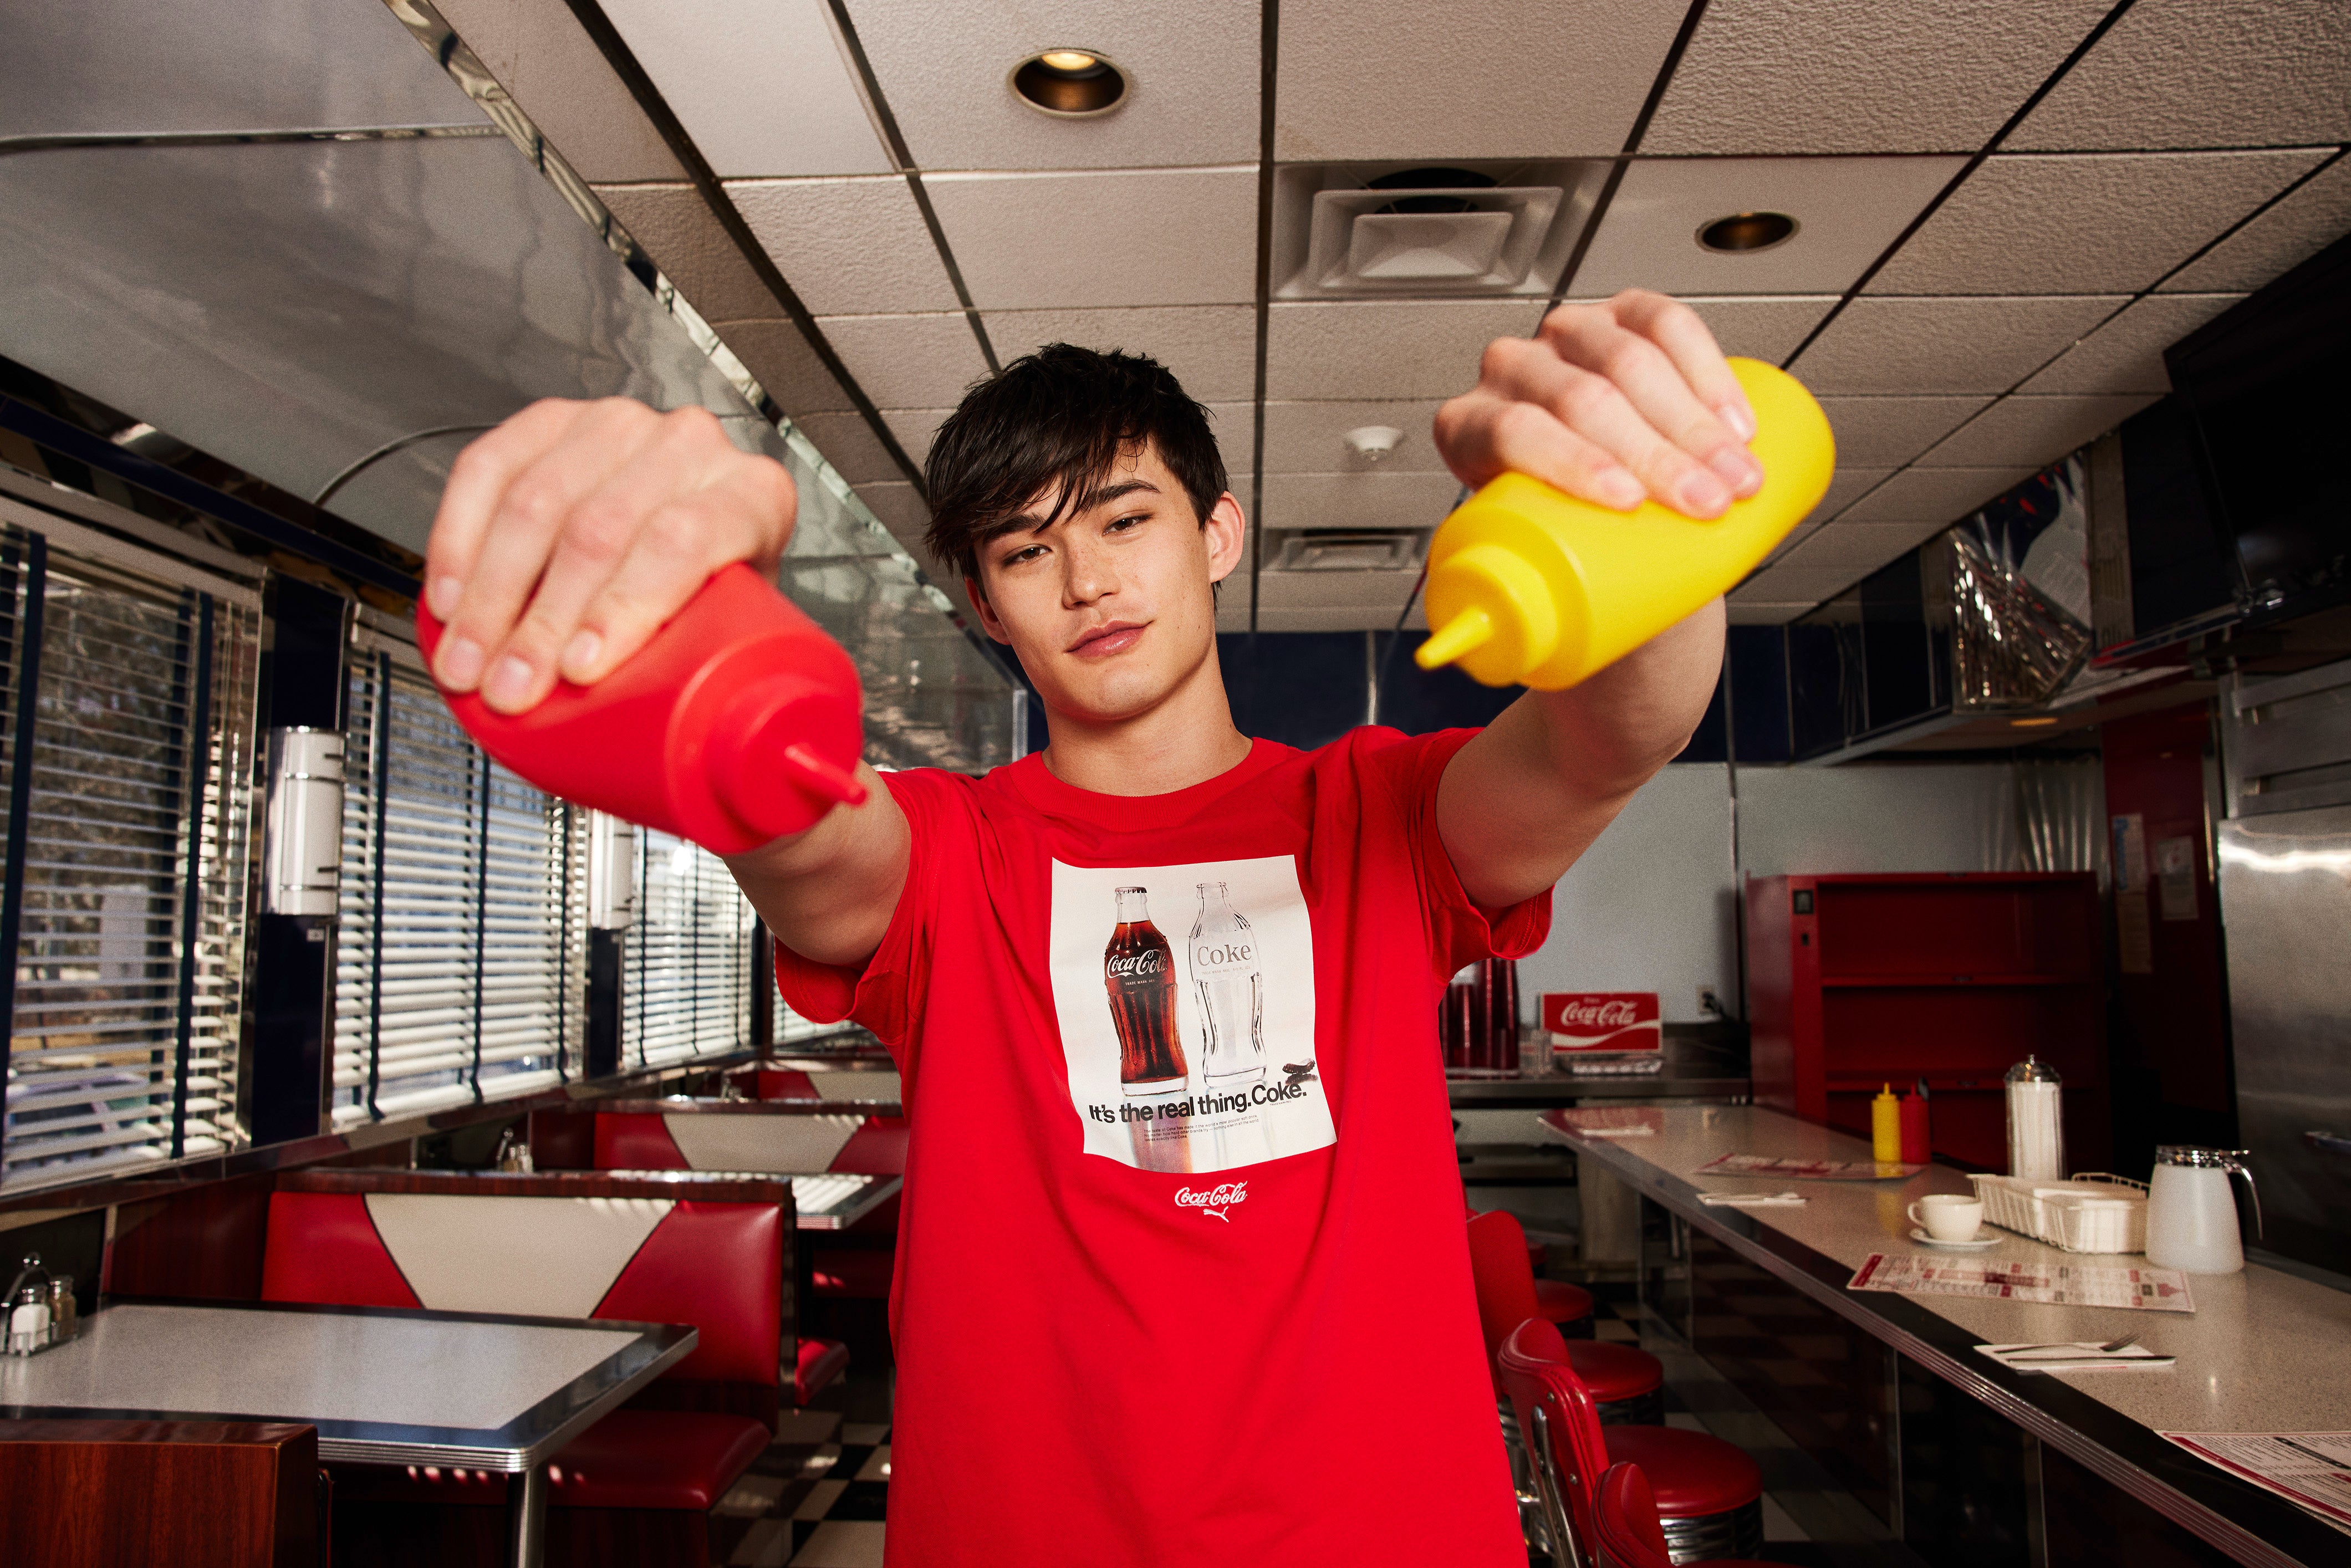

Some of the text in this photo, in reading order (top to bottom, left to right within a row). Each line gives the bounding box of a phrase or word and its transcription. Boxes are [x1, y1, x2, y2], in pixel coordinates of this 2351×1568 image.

[1197, 944, 1252, 966] Coke
[1089, 1104, 1115, 1123] It's
[1119, 1102, 1154, 1122] the
[1157, 1096, 1195, 1120] real
[1252, 1081, 1307, 1105] Coke.
